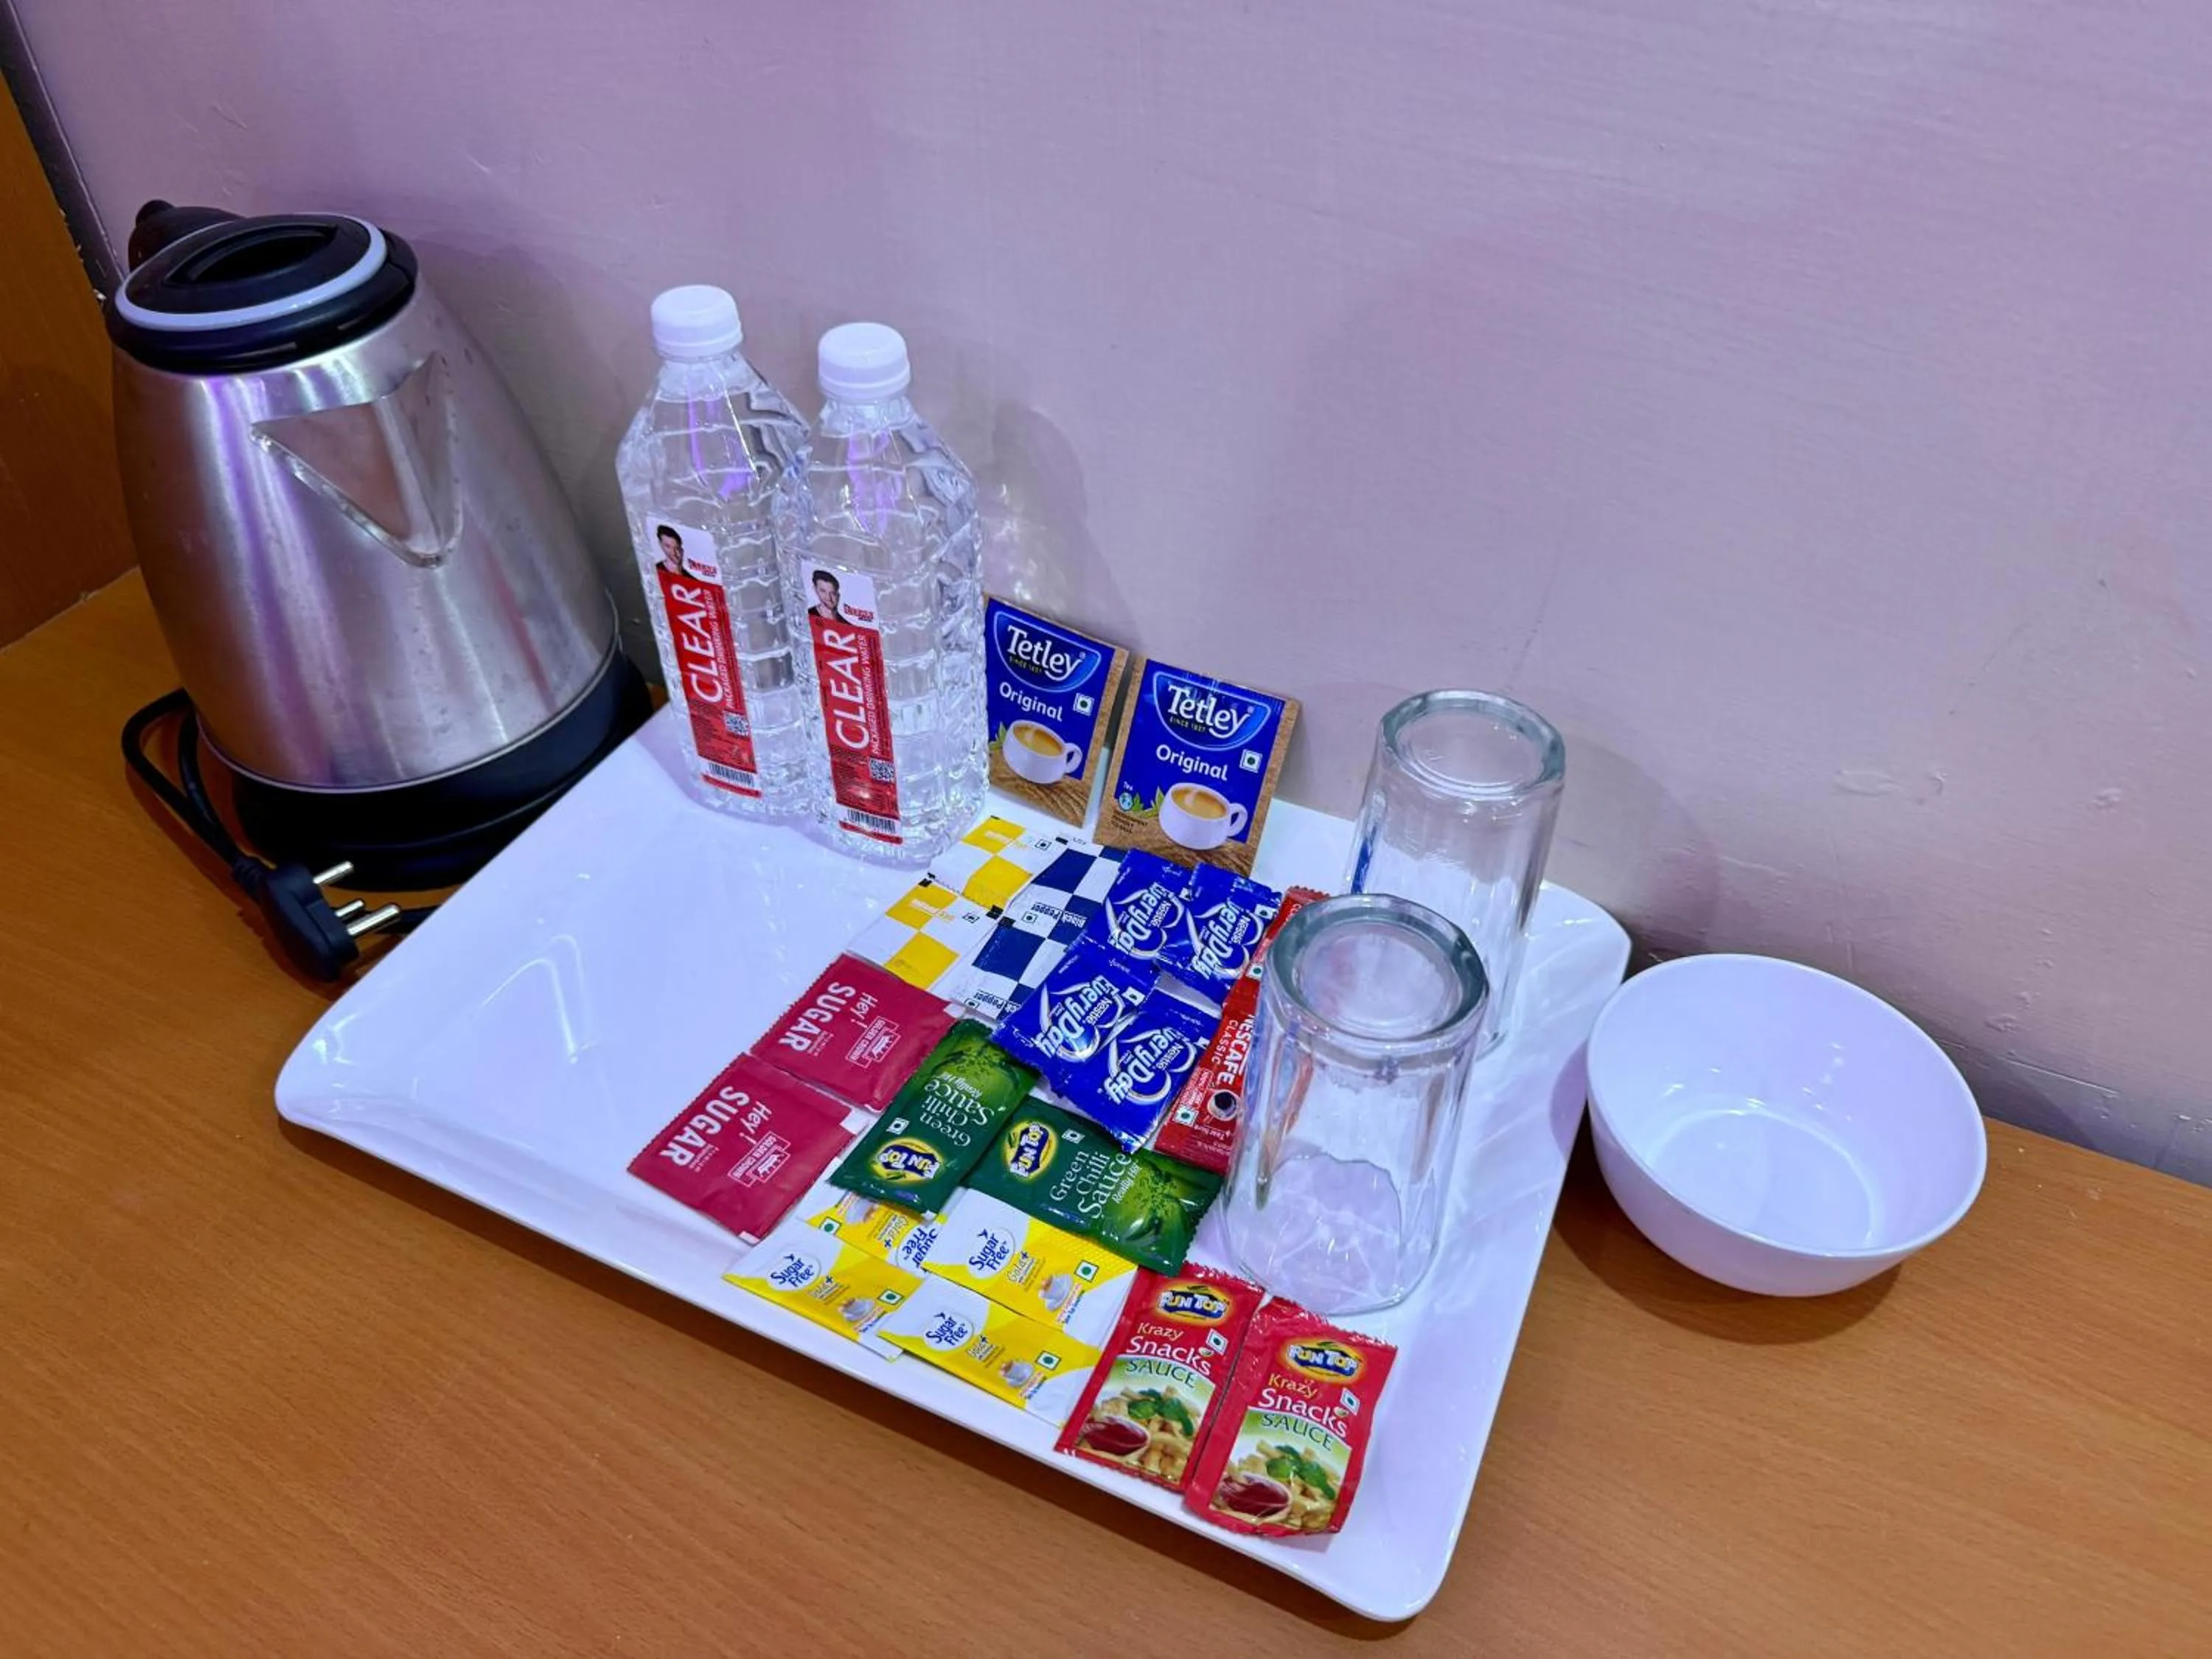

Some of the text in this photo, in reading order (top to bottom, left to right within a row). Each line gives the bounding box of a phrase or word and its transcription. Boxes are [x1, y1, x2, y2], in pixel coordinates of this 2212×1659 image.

[670, 583, 724, 703] CLEAR
[1007, 625, 1083, 681] Tetley
[823, 629, 870, 750] CLEAR
[862, 667, 876, 711] DRINKING
[999, 681, 1062, 722] Original
[1167, 684, 1251, 739] Tetley
[868, 712, 881, 755] PACKAGED
[1156, 744, 1228, 781] Original
[1031, 902, 1062, 920] Pepper
[778, 982, 856, 1051] SUGAR
[1211, 1020, 1238, 1065] CLASSIC
[921, 1095, 968, 1126] Chilli
[924, 1079, 995, 1126] Sauce
[659, 1086, 750, 1166] SUGAR
[919, 1112, 971, 1147] Green
[1049, 1151, 1090, 1201] Green
[1076, 1151, 1110, 1195] Chilli
[1077, 1152, 1132, 1219] Sauce
[1112, 1178, 1134, 1204] Really
[902, 1228, 928, 1254] Free
[969, 1233, 999, 1270] Sugar
[987, 1245, 1009, 1270] Free
[771, 1258, 804, 1284] Sugar
[788, 1268, 815, 1288] Free
[1158, 1291, 1194, 1310] FUN
[926, 1316, 957, 1343] Sugar
[944, 1326, 968, 1346] Free
[1137, 1322, 1185, 1341] Krazy
[1126, 1335, 1211, 1376] Snacks
[1287, 1344, 1324, 1364] FUN
[1126, 1359, 1195, 1388] SAUCE
[1268, 1373, 1318, 1399] Krazy
[1258, 1388, 1348, 1438] Snacks
[1262, 1413, 1332, 1452] SAUCE
